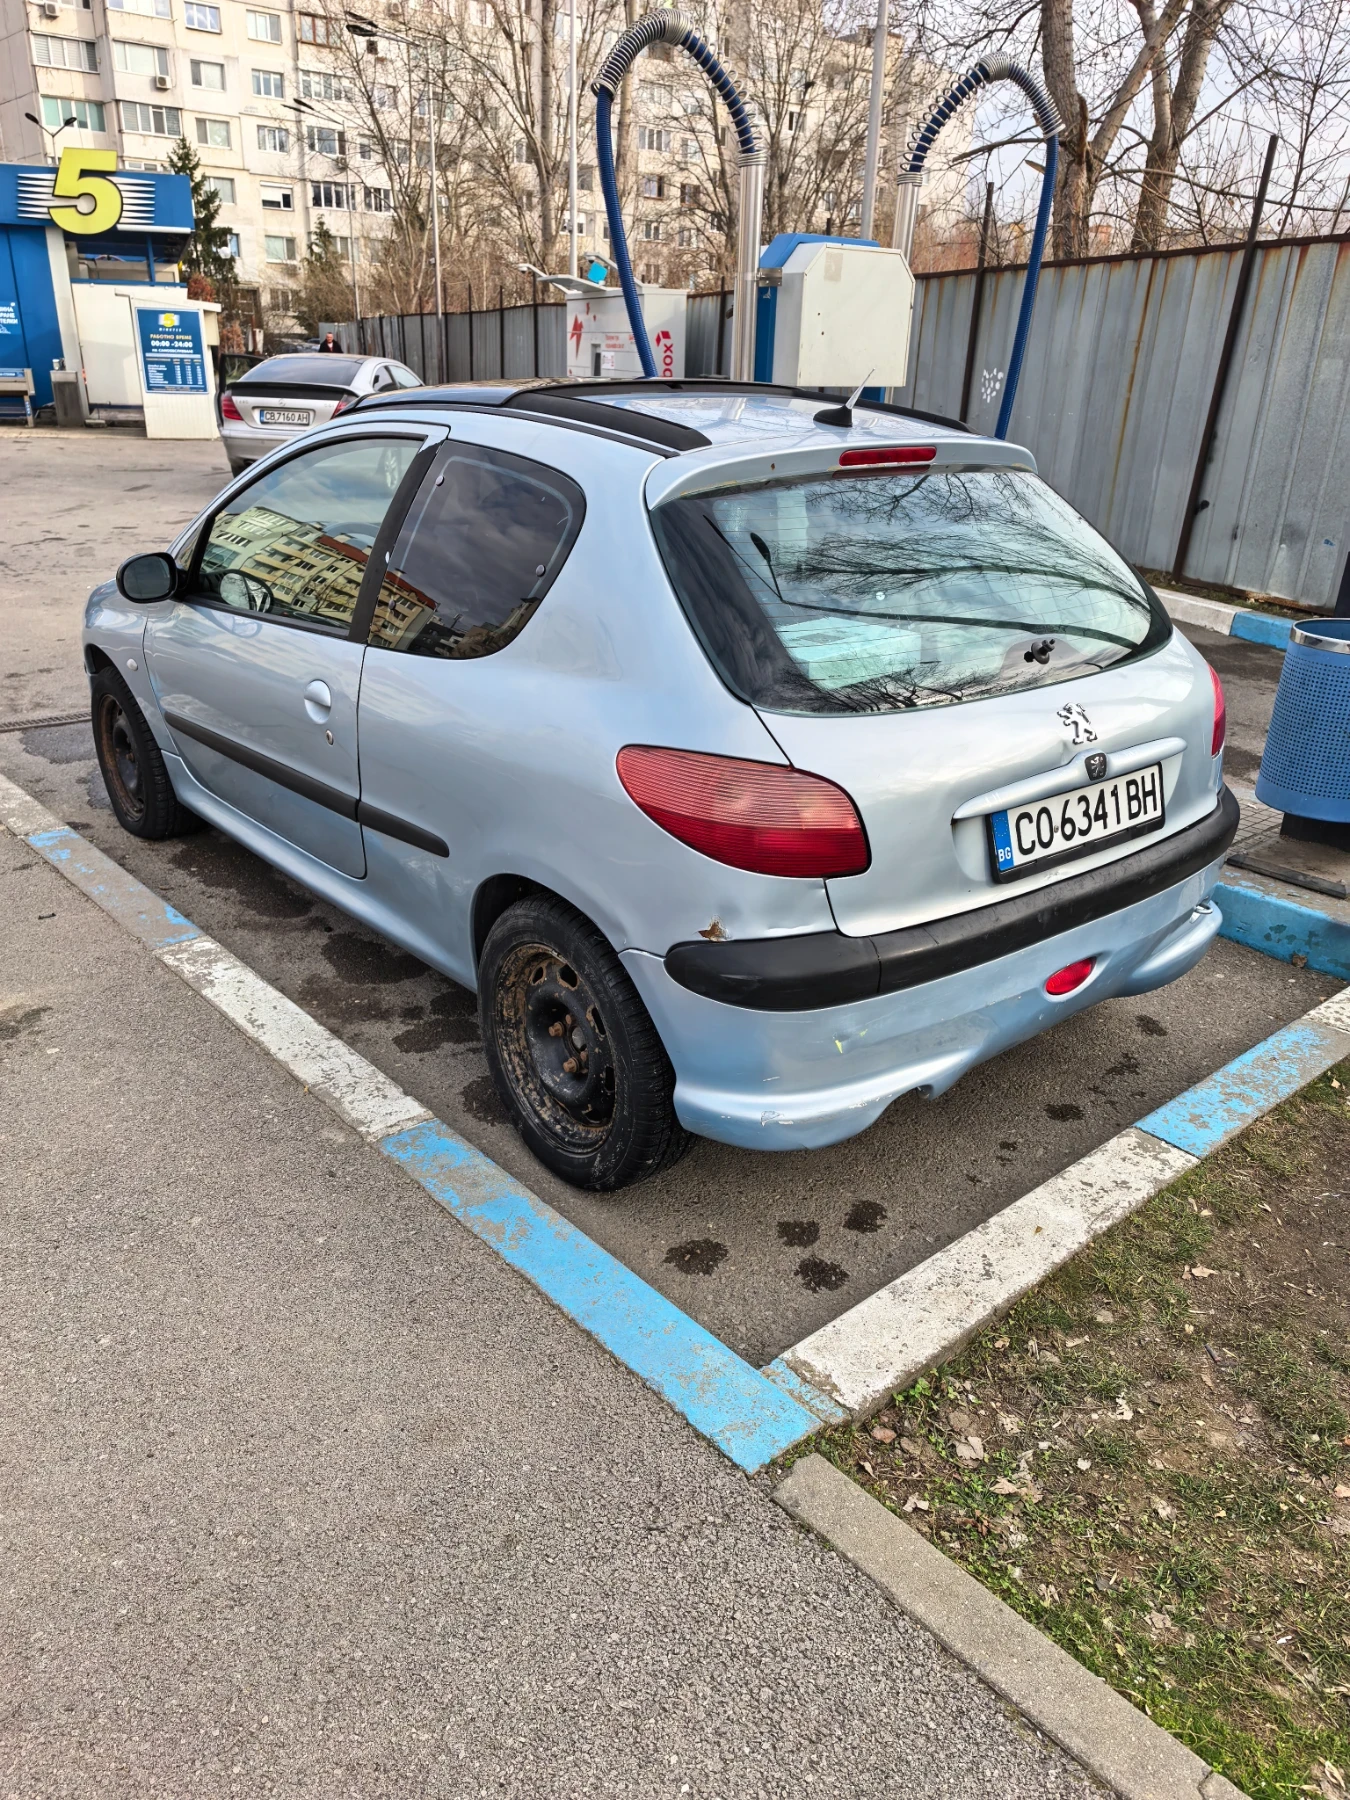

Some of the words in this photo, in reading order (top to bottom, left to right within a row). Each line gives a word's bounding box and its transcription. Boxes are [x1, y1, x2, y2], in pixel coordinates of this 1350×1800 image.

[48, 147, 123, 235] 5
[163, 313, 175, 328] 5
[1060, 784, 1121, 841] 6341
[1125, 772, 1158, 820] BH
[998, 848, 1012, 862] BG
